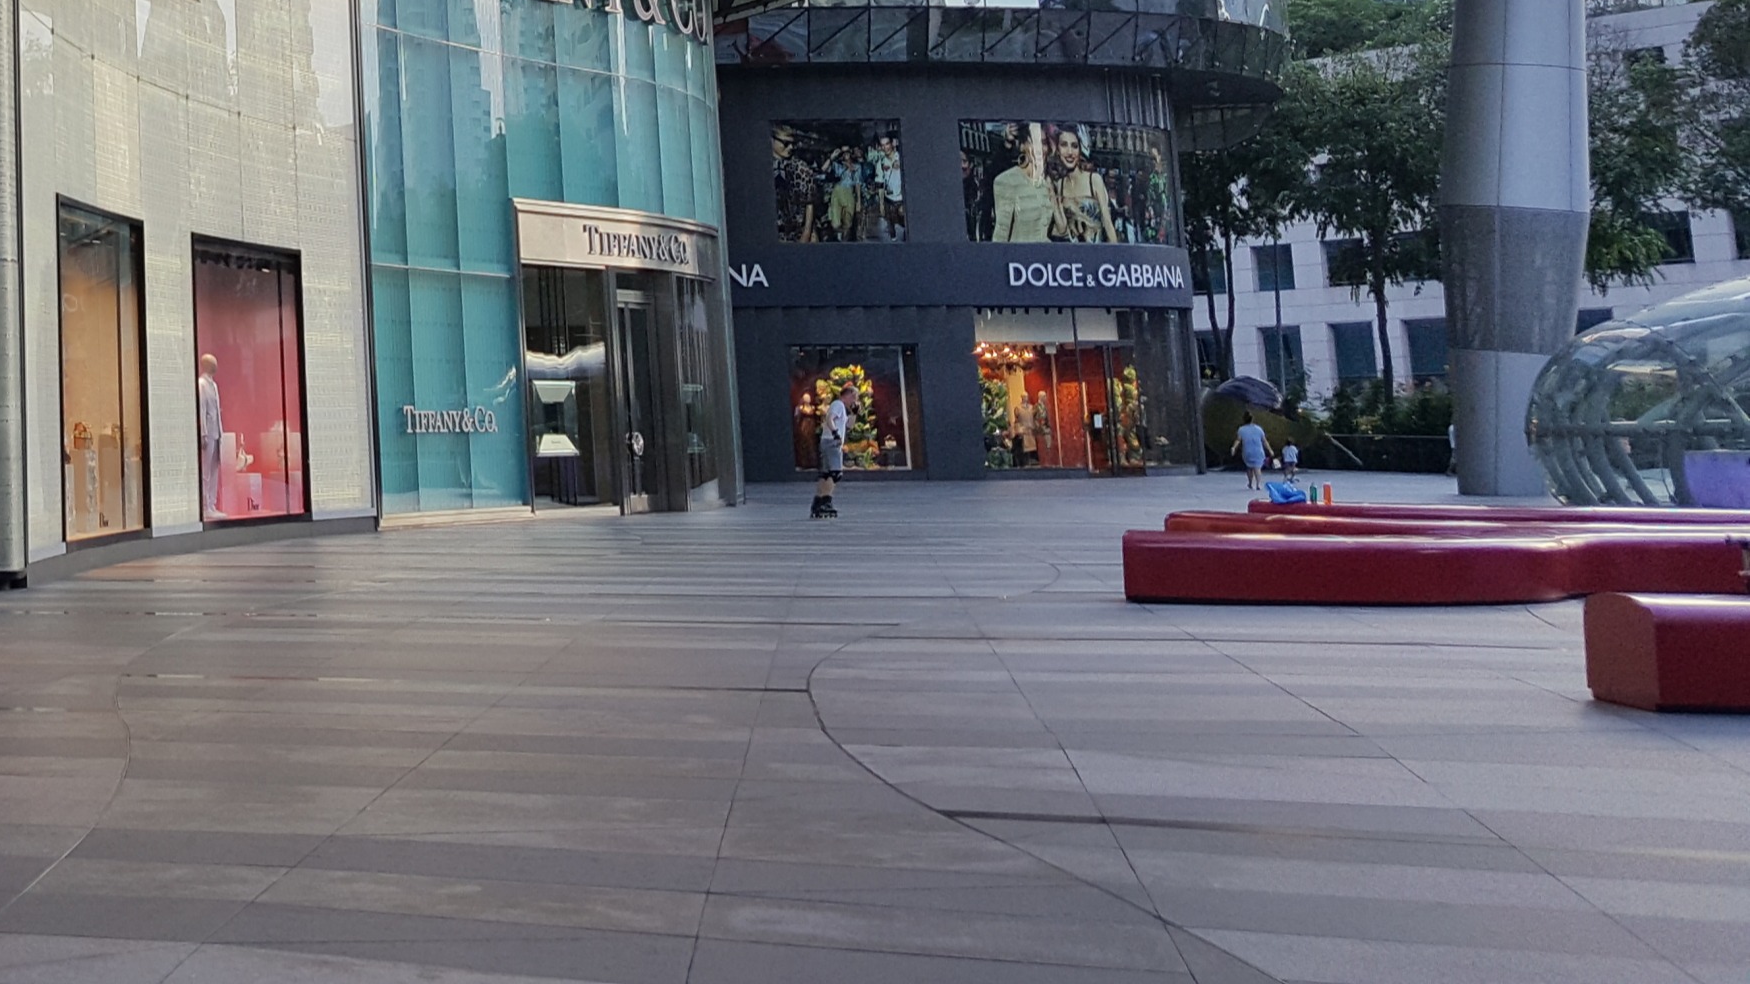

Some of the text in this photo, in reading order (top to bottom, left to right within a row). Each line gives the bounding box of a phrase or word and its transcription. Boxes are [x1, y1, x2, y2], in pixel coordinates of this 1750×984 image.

[1008, 262, 1185, 289] DOLCE & GABBANA
